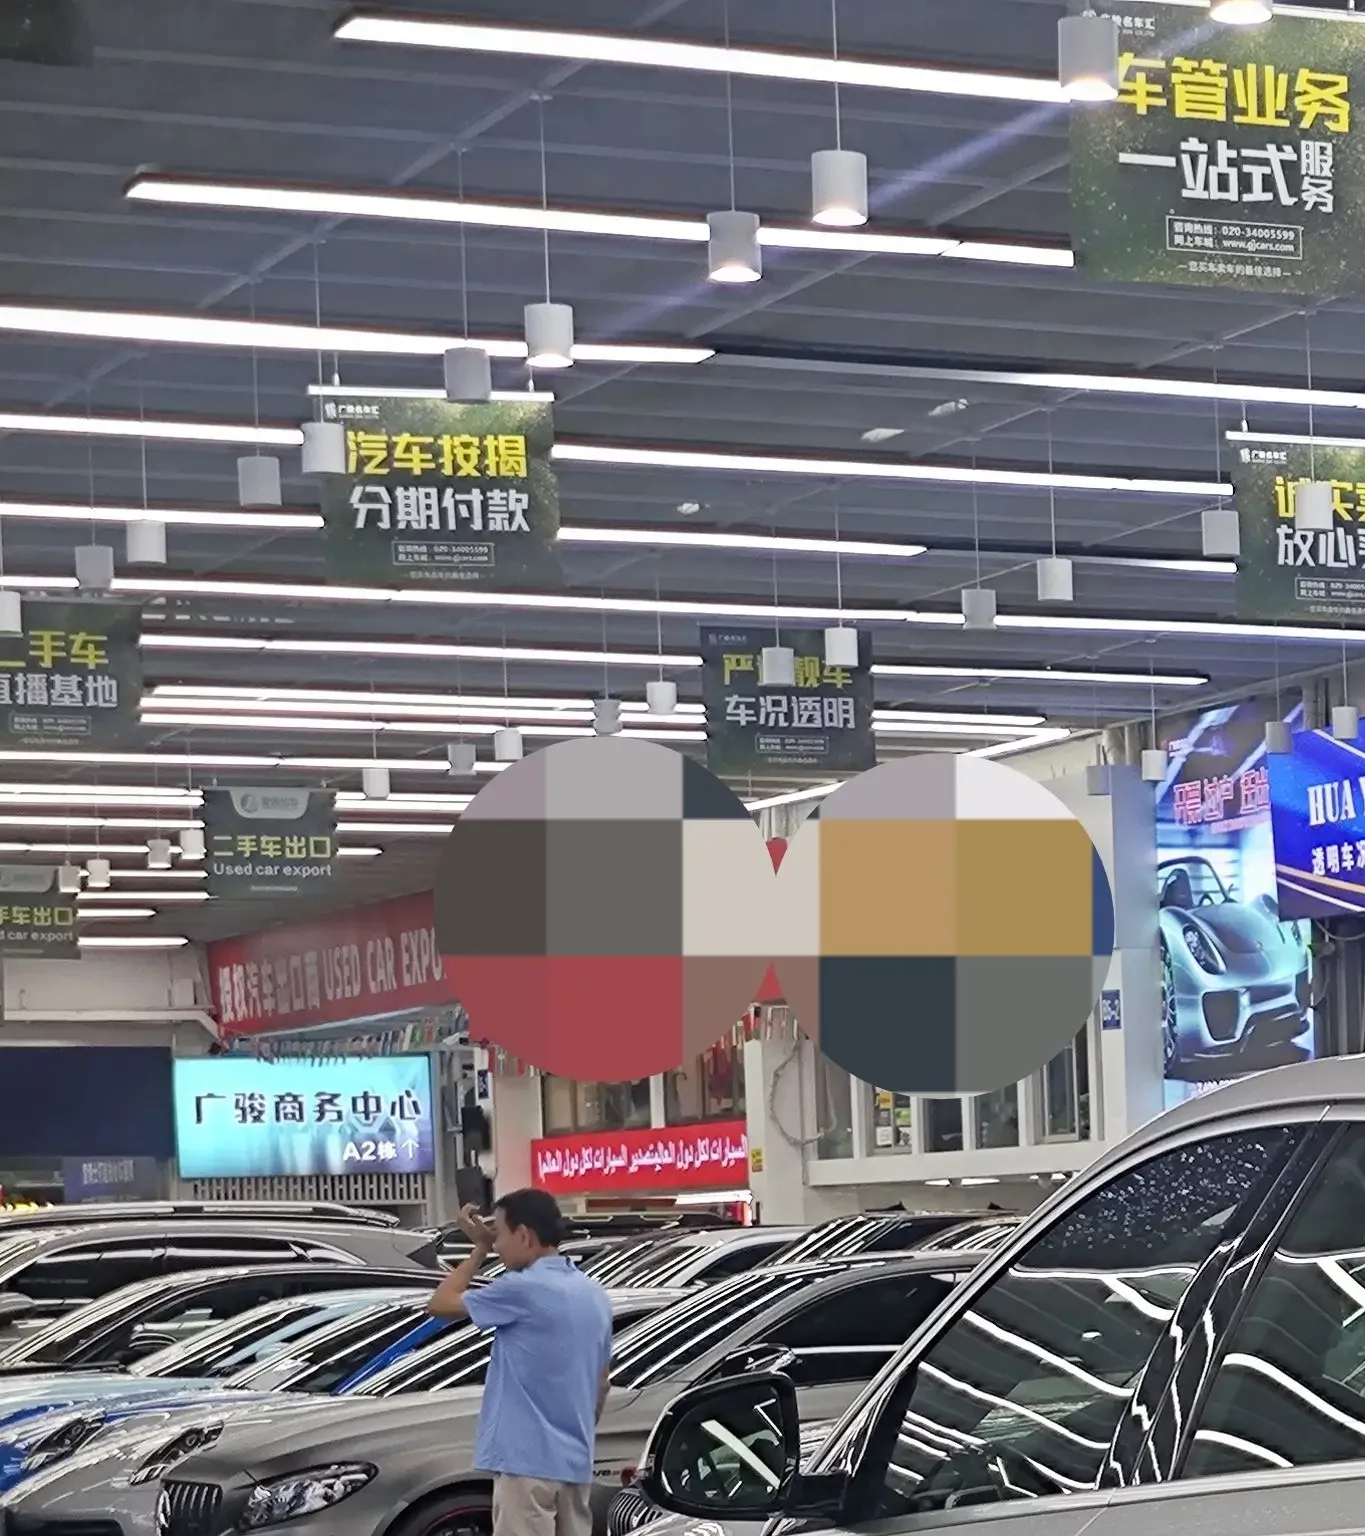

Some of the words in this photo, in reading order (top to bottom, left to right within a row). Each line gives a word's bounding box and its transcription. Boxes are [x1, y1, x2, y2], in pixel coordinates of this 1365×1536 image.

[1118, 52, 1350, 133] 车管业务
[346, 429, 528, 478] 汽车按揭
[349, 485, 531, 532] 分期付款
[722, 653, 853, 689] 严靓车
[725, 694, 856, 729] 车况透明
[1307, 779, 1357, 826] HUA
[212, 834, 332, 860] 二手车出口
[212, 862, 253, 876] Used
[255, 864, 280, 876] car
[282, 864, 332, 879] export
[320, 943, 362, 1002] USED
[366, 935, 398, 995] CAR
[194, 1091, 421, 1126] 广骏商务中心
